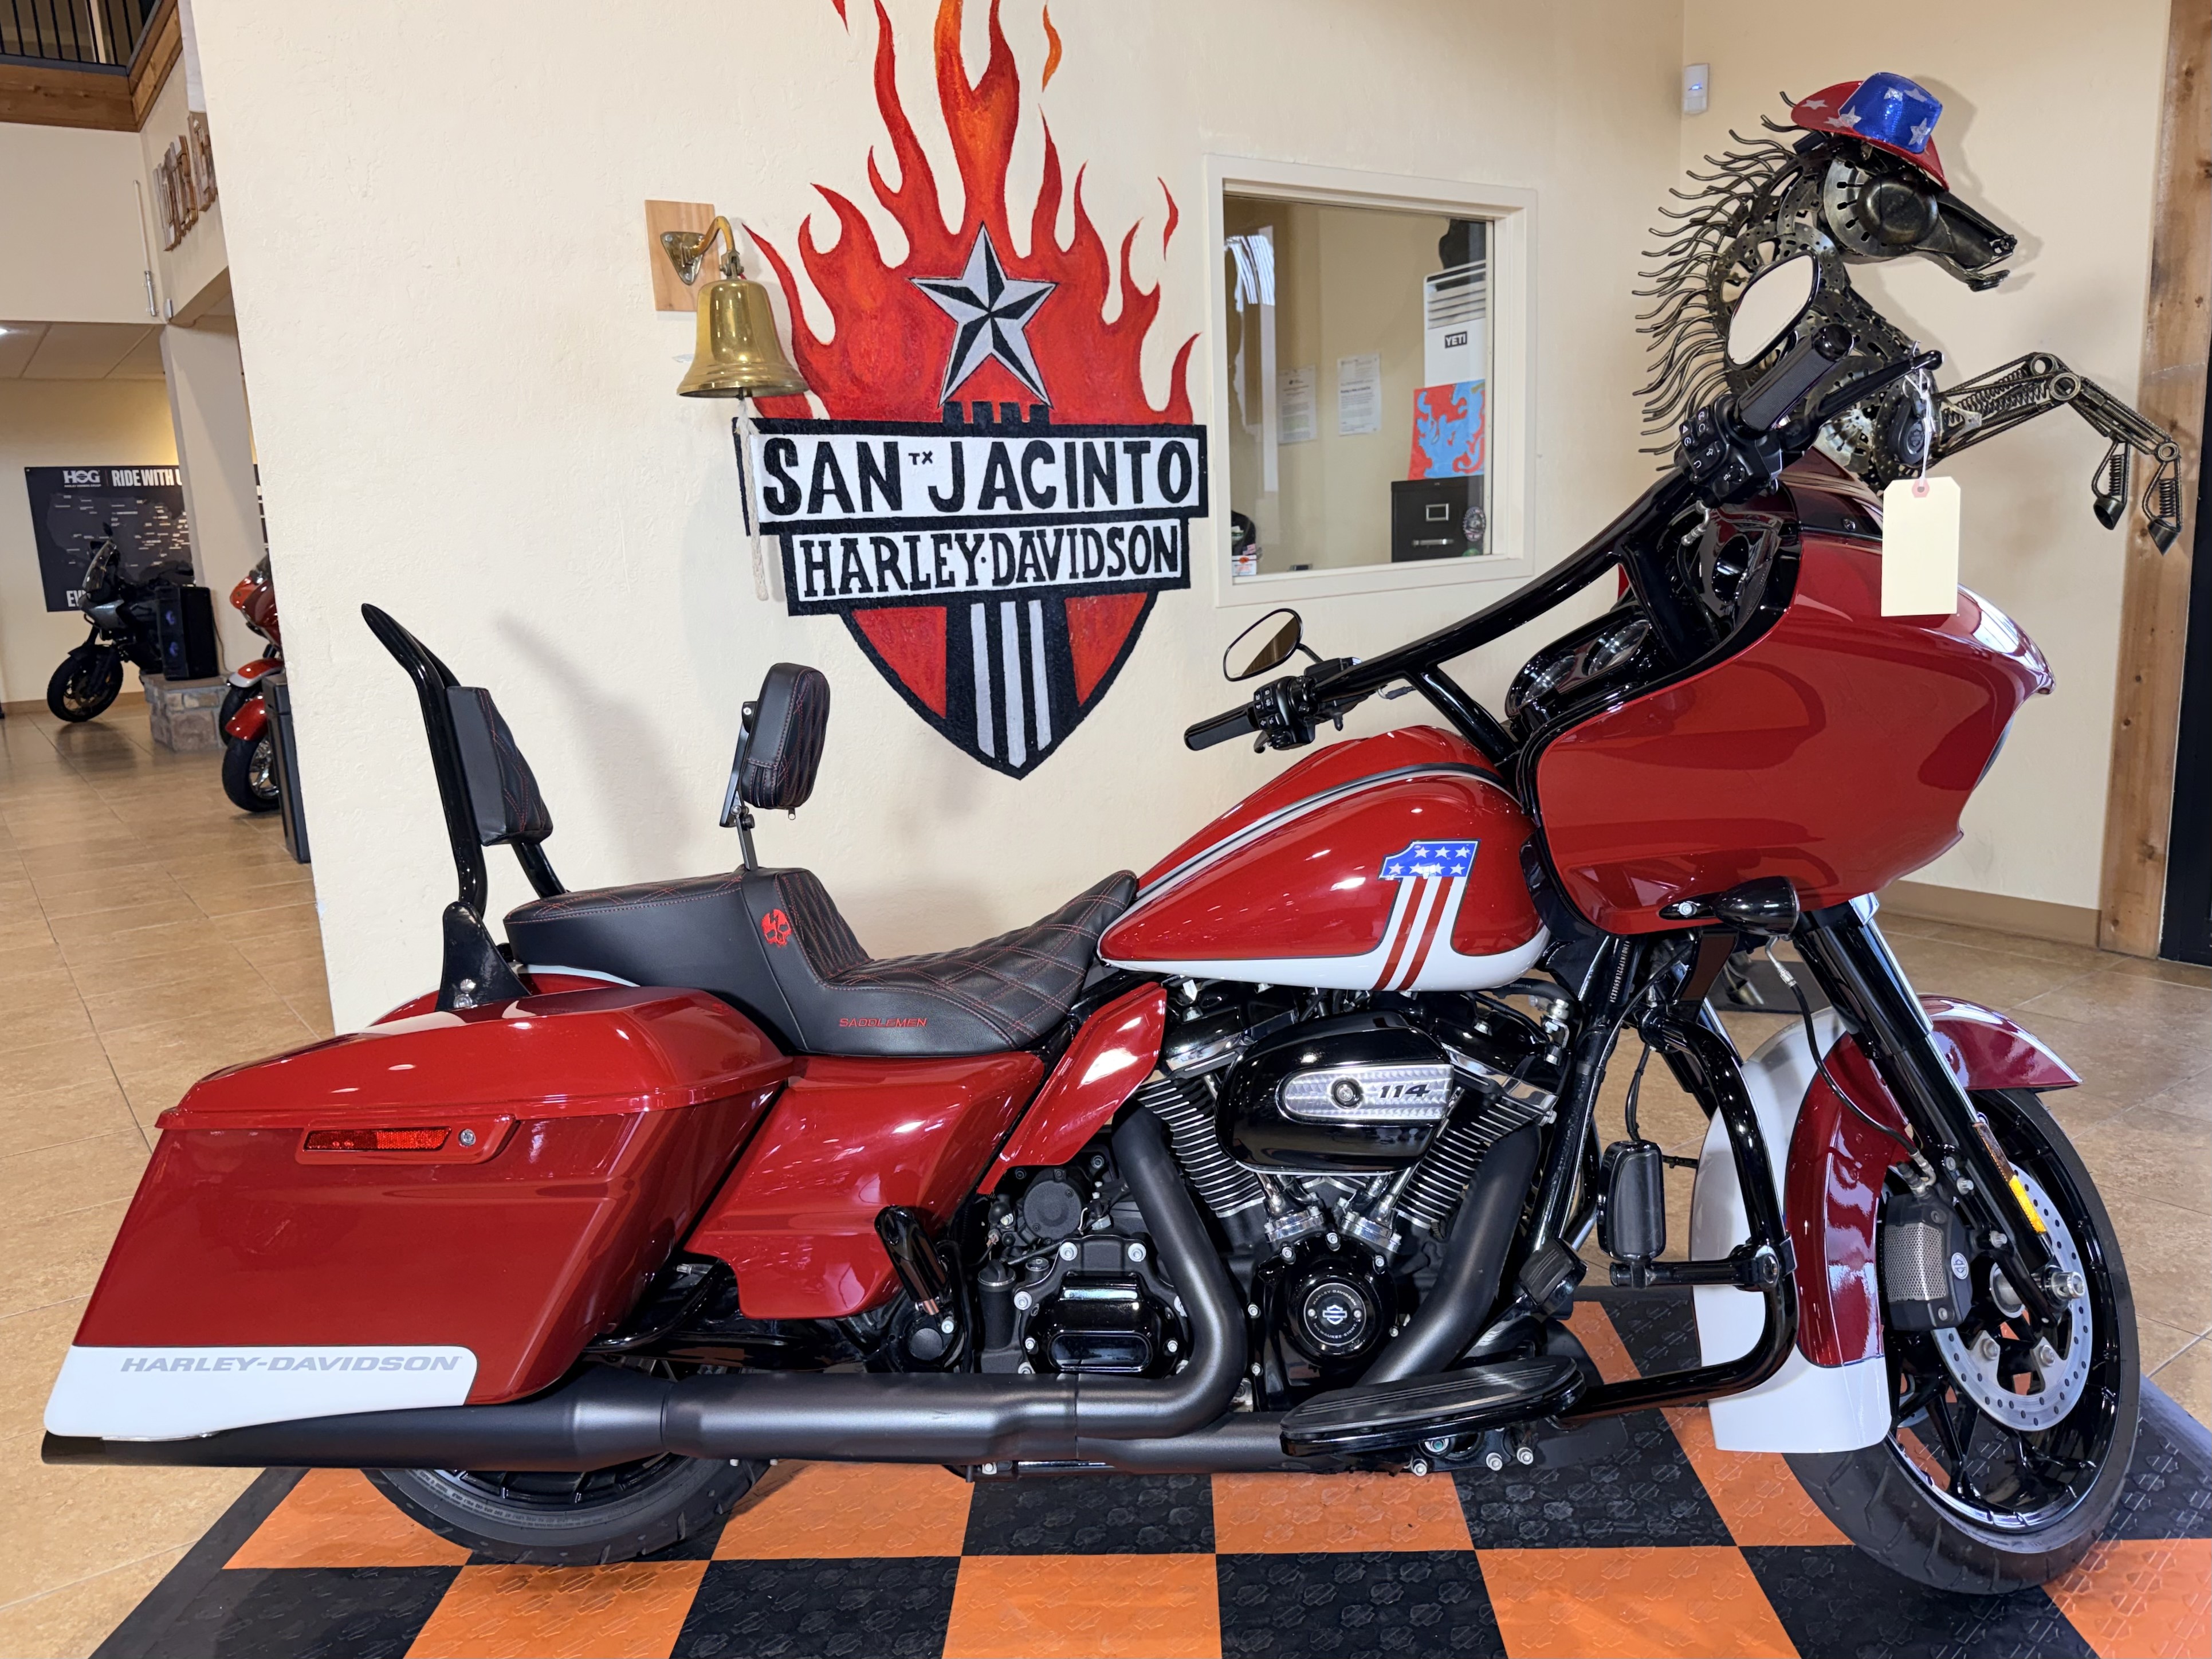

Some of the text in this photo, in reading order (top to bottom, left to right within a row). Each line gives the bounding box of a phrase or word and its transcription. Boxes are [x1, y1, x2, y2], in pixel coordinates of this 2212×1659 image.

[1445, 334, 1466, 346] YETI
[908, 450, 933, 465] TX
[62, 470, 101, 484] HOG
[111, 469, 141, 487] RIDE
[140, 469, 175, 486] WITH
[763, 438, 1192, 515] SAN JACINTO
[839, 1017, 928, 1027] SADDLEMEN
[1380, 1084, 1431, 1099] 114
[120, 1356, 461, 1372] HARLEY-DAVIDSON
